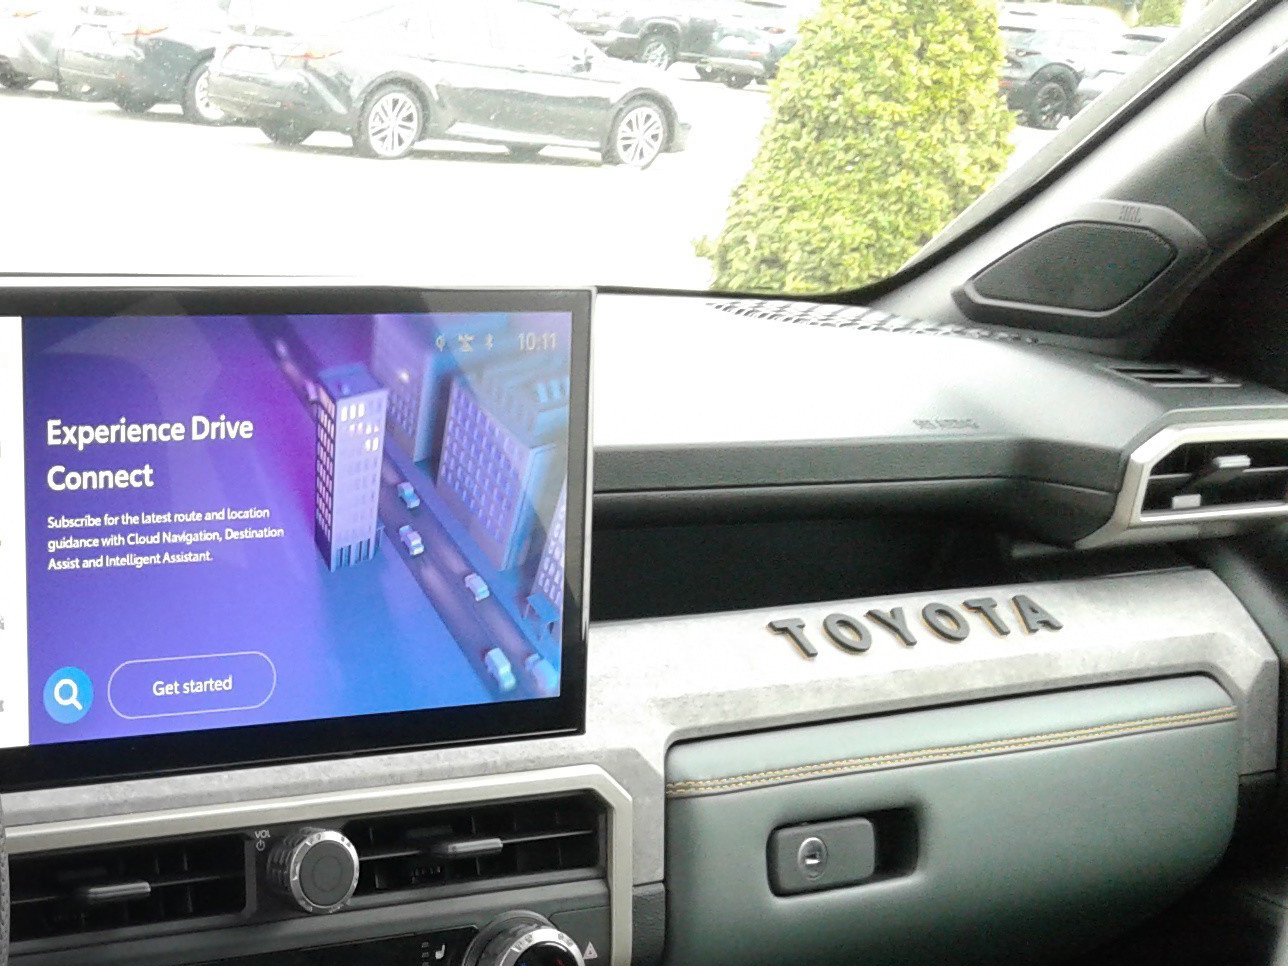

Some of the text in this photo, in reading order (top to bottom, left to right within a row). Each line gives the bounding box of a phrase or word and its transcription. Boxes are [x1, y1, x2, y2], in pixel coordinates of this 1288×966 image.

[46, 414, 254, 451] Experience Drive
[47, 464, 154, 491] Connect
[47, 507, 271, 530] Subscribe for the latest route and location
[48, 527, 285, 552] guidance with Cloud Navigation, Destination
[48, 550, 214, 571] Assist and Intelligent Assistant.
[766, 594, 1064, 660] TOYOTA
[152, 675, 233, 697] Get started
